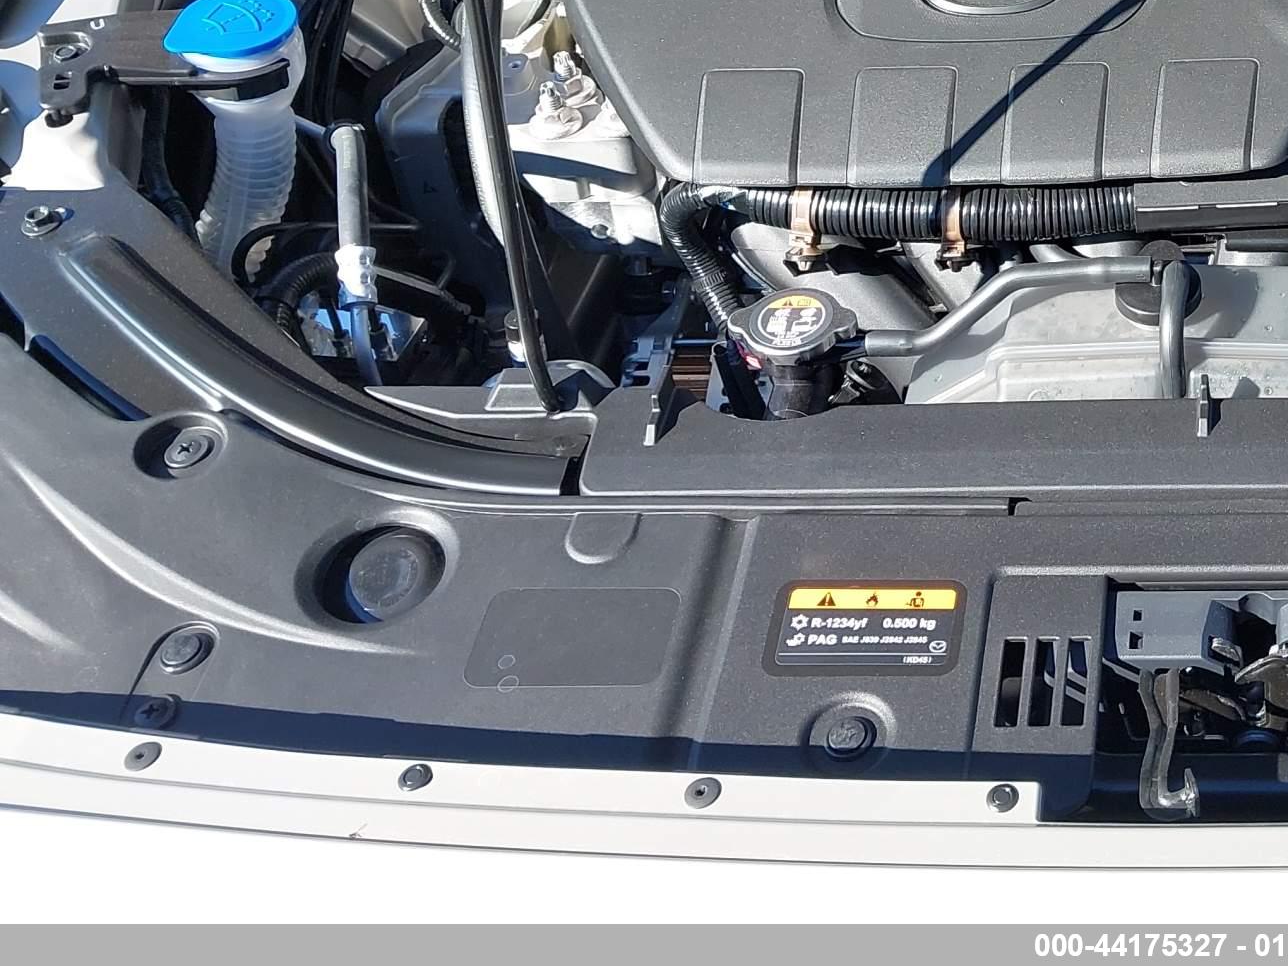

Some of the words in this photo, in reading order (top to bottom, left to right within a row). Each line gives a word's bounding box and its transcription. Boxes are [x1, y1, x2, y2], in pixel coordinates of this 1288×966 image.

[811, 618, 868, 630] R-1234yf
[882, 618, 917, 628] 0.500
[920, 618, 936, 630] kg
[807, 634, 837, 645] PAG
